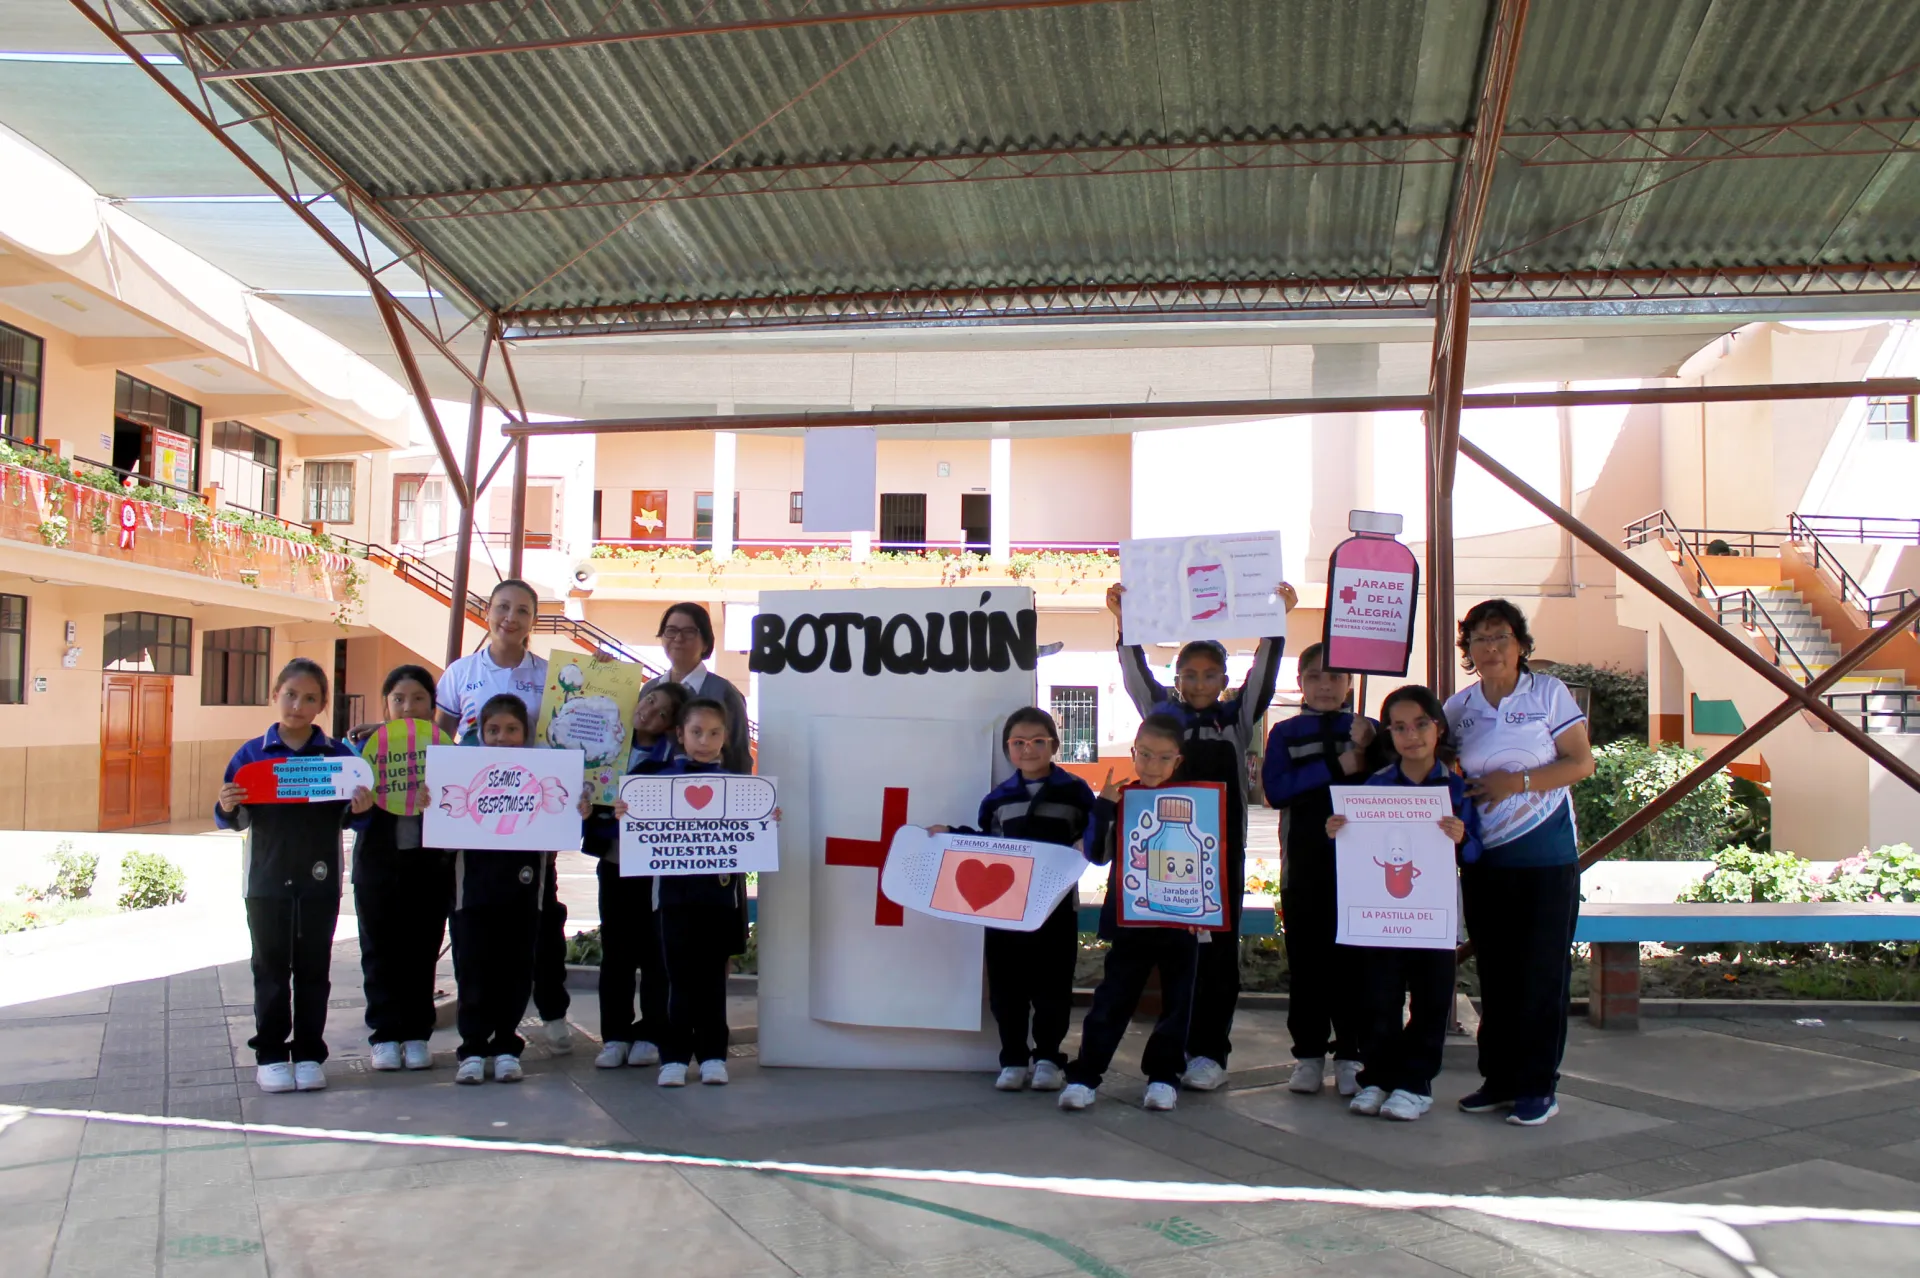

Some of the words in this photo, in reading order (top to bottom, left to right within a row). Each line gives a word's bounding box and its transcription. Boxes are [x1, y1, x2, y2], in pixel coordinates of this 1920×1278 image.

[1354, 578, 1404, 591] JARABE
[1368, 594, 1384, 604] DE
[1388, 596, 1403, 605] LA
[1347, 606, 1402, 619] ALEGRÍA
[748, 590, 1038, 676] BOTIQUÍN
[273, 765, 328, 774] Respetemos
[330, 764, 343, 772] los
[378, 764, 426, 779] nuestr
[278, 775, 319, 784] derechos
[321, 775, 332, 783] de
[488, 769, 522, 788] SEAMOS
[277, 788, 301, 796] todas
[312, 787, 336, 795] todos
[375, 779, 424, 794] esfuer
[1346, 796, 1413, 806] PONGÁMONOS
[1356, 811, 1385, 819] LUGAR
[1388, 811, 1404, 819] DEL
[1406, 811, 1432, 819] OTRO
[758, 821, 769, 831] Y
[638, 831, 755, 844] COMPARTAMOS
[652, 844, 738, 857] NUESTRAS
[649, 858, 738, 870] OPINIONES
[1162, 887, 1189, 895] Jarabe
[1172, 896, 1199, 905] Alegría
[1362, 911, 1373, 919] LA
[1375, 911, 1415, 920] PASTILLA
[1417, 912, 1434, 920] DEL
[1382, 926, 1412, 934] ALIVIO
